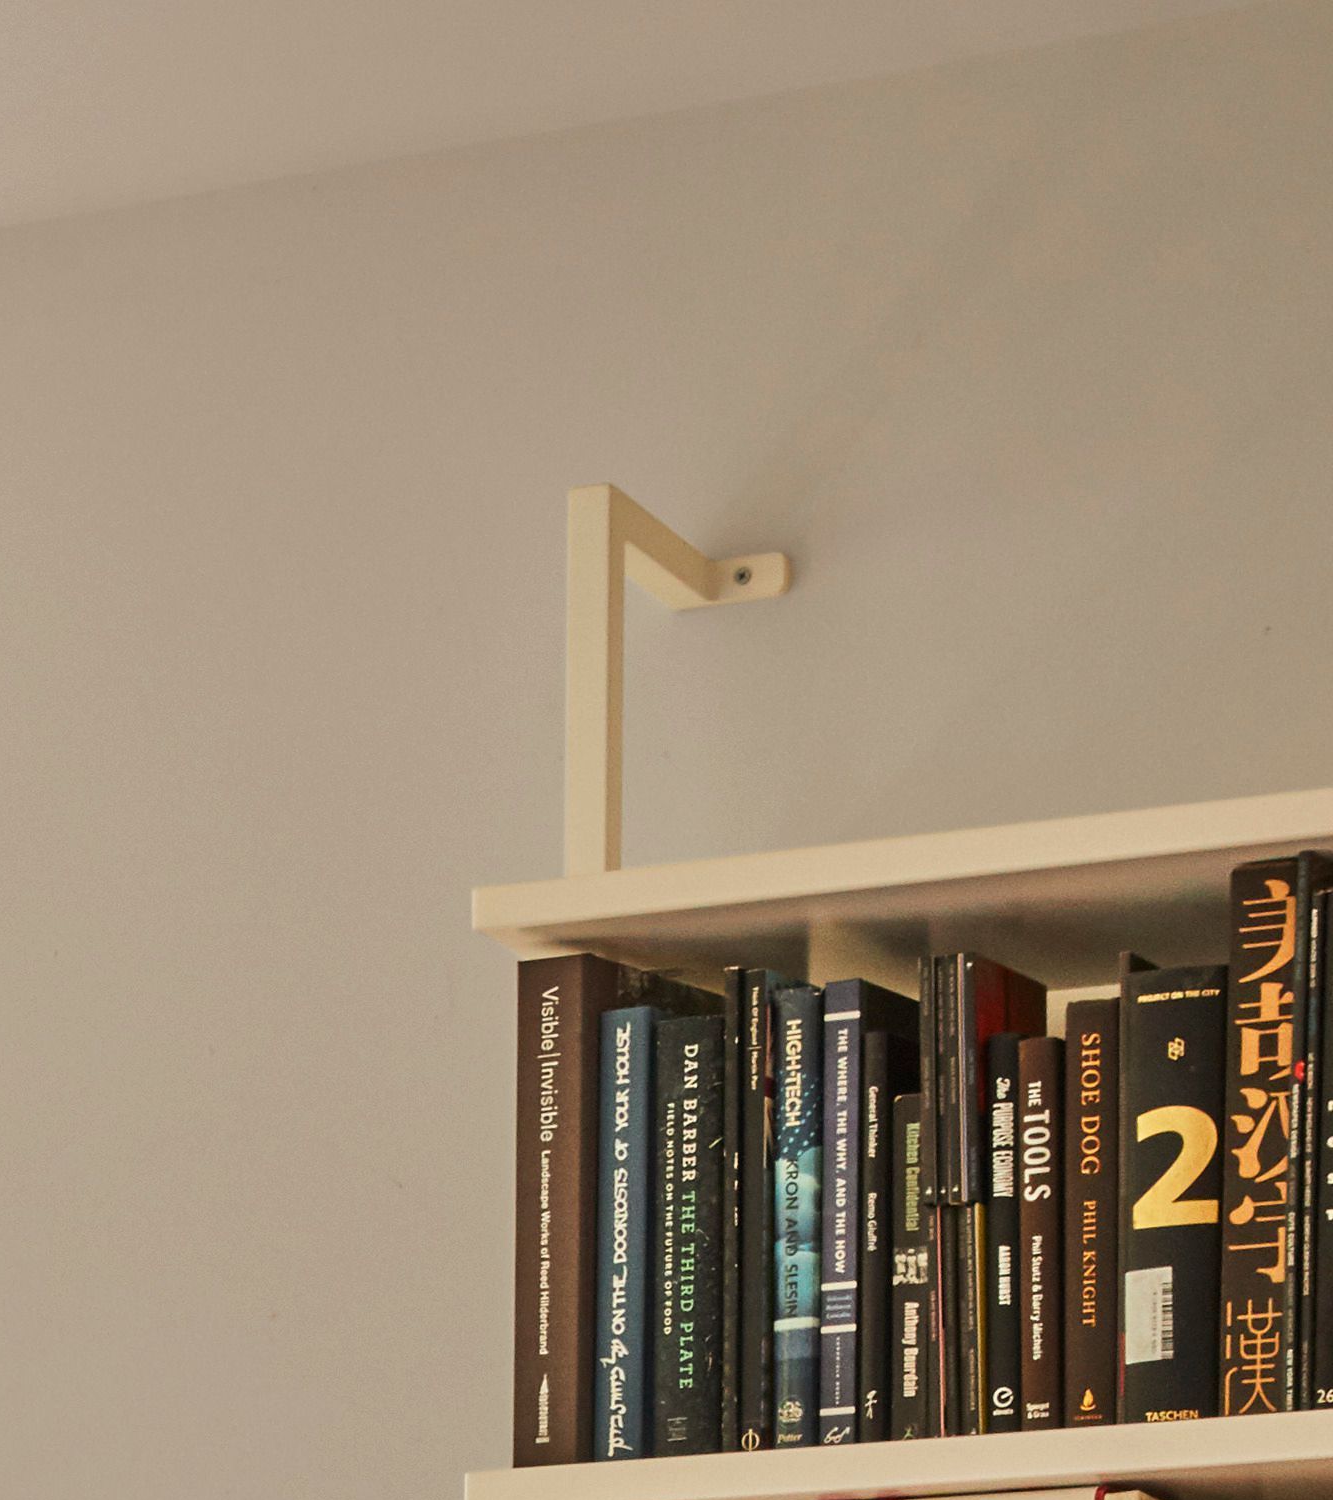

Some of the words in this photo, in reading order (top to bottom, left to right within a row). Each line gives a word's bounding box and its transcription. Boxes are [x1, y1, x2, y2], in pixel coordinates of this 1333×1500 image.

[683, 1045, 699, 1089] DAN
[1081, 1033, 1101, 1105] SHOE
[1027, 1081, 1041, 1106] THE
[666, 1103, 674, 1136] FIELD
[682, 1099, 698, 1182] BARBER
[665, 1141, 674, 1179] NOTES
[1023, 1110, 1051, 1201] TOOLS
[1080, 1116, 1101, 1175] DOG
[1132, 1104, 1219, 1230] 2
[665, 1184, 674, 1201] ON
[681, 1191, 696, 1234] THE
[665, 1205, 673, 1229] THE
[1082, 1200, 1097, 1243] PHIL
[664, 1232, 673, 1276] FUTURE
[664, 1282, 672, 1296] OF
[679, 1244, 695, 1311] THIRD
[1081, 1251, 1097, 1327] KNIGHT
[663, 1301, 672, 1334] FOOD
[679, 1322, 694, 1389] PLATE
[1145, 1409, 1199, 1422] TASCHEN
